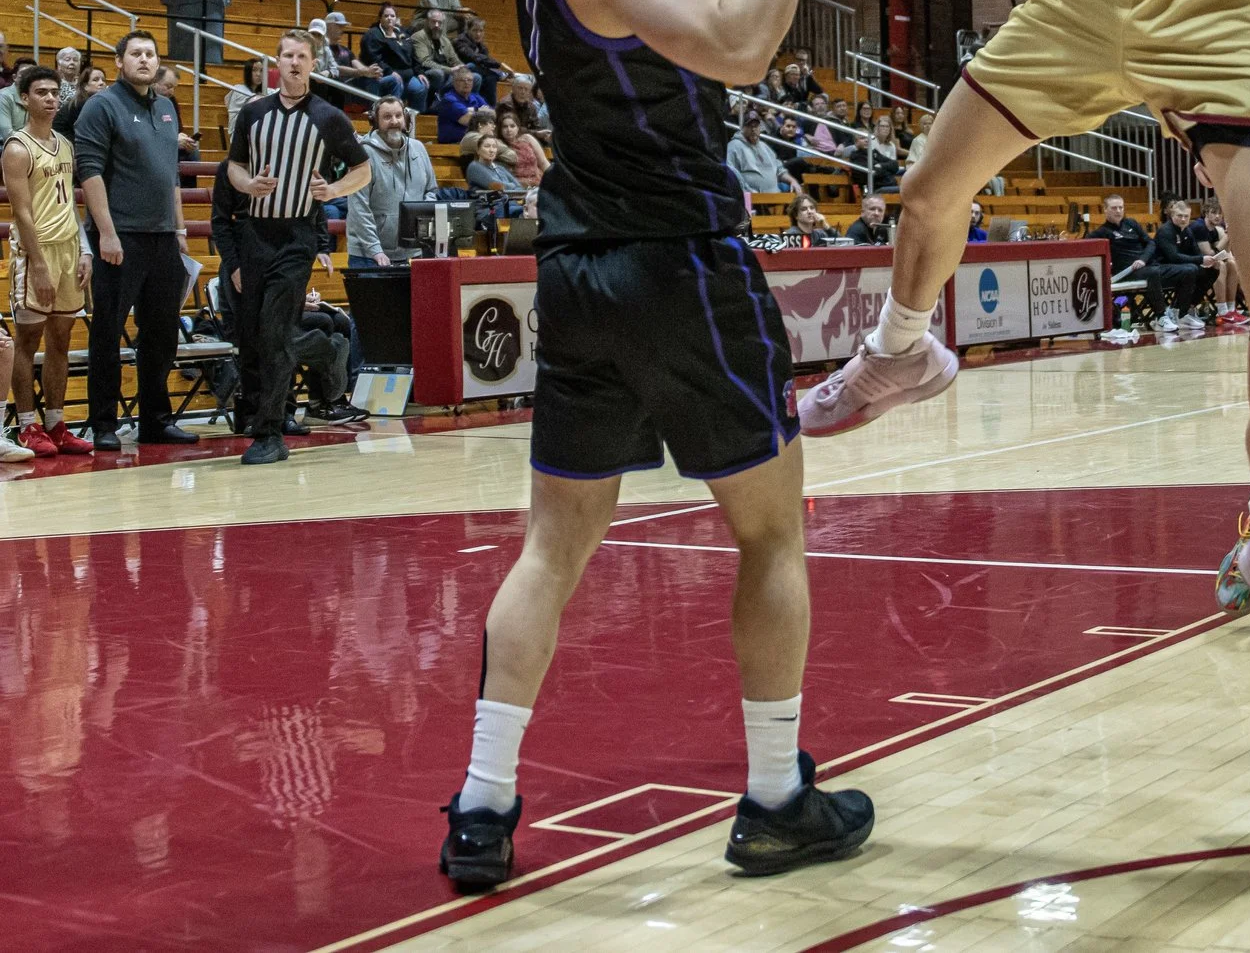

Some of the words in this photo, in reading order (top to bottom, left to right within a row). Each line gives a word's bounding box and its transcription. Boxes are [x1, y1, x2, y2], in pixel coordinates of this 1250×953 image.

[55, 179, 68, 204] 11
[1031, 275, 1069, 296] GRAND
[1032, 299, 1069, 316] HOTEL
